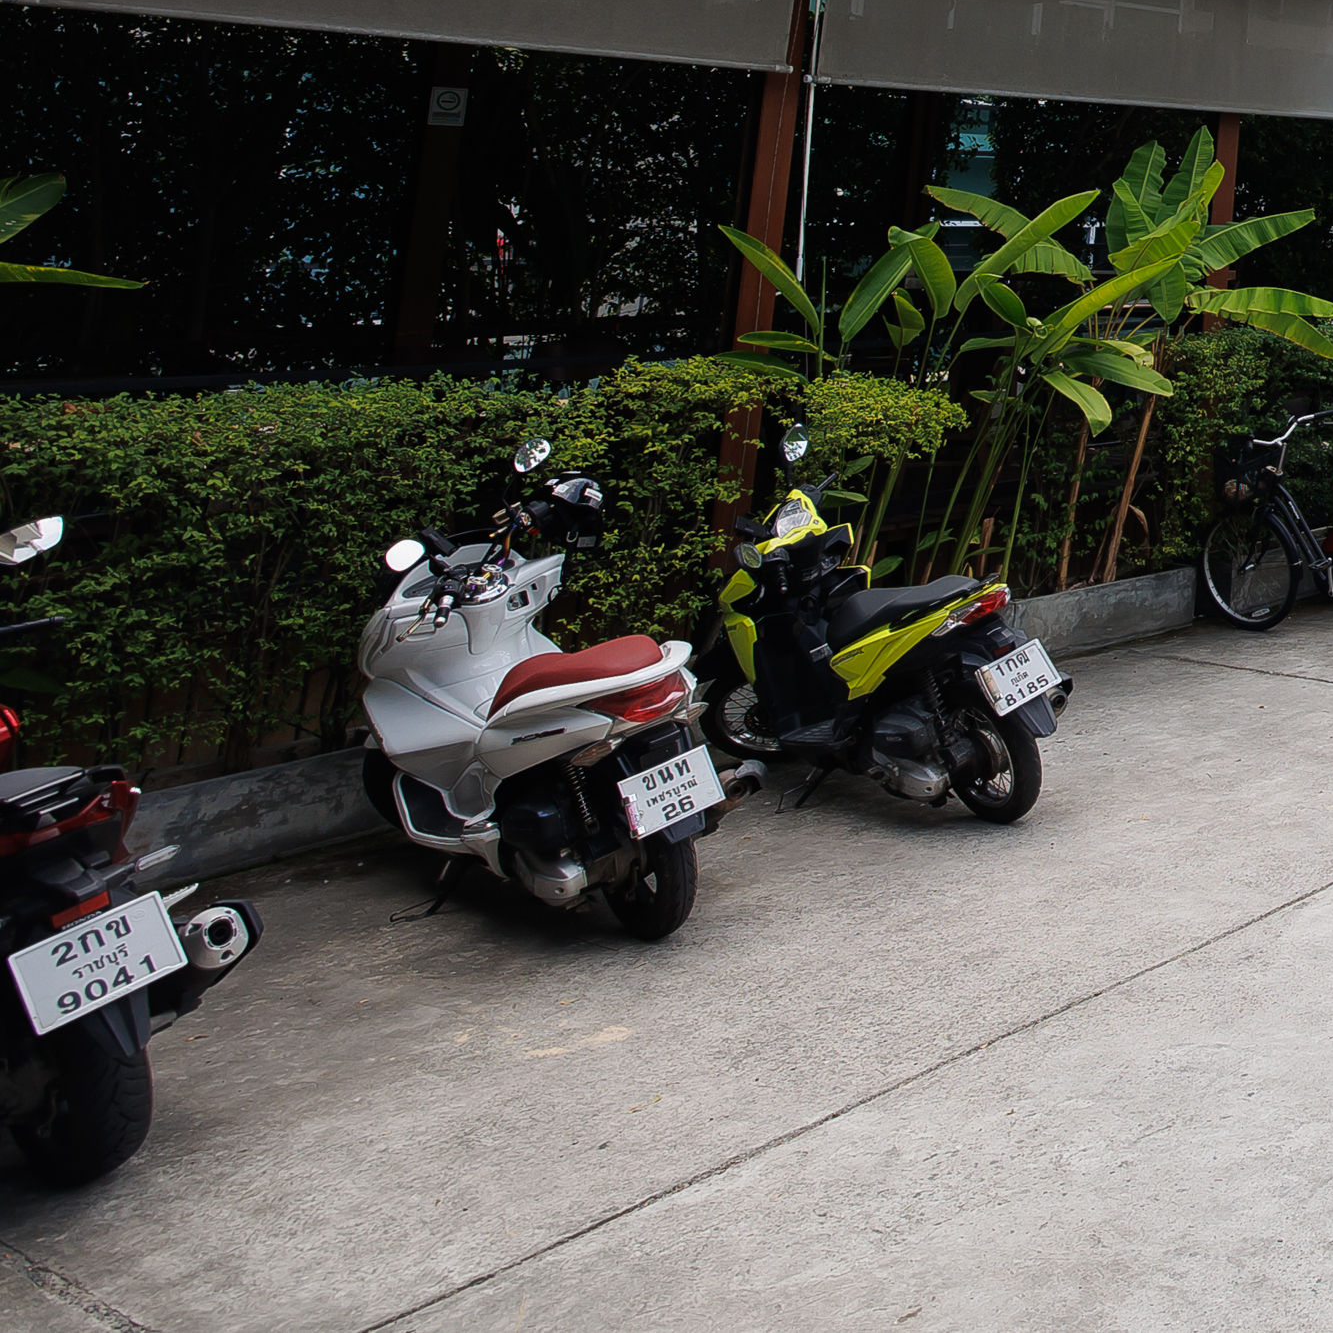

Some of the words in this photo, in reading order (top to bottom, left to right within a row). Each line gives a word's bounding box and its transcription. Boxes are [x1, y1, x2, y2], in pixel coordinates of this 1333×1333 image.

[1004, 674, 1050, 707] 8185
[661, 794, 696, 822] 26
[51, 915, 133, 968] 2กข
[71, 942, 130, 979] ราชบุรี
[56, 953, 158, 1015] 9041
